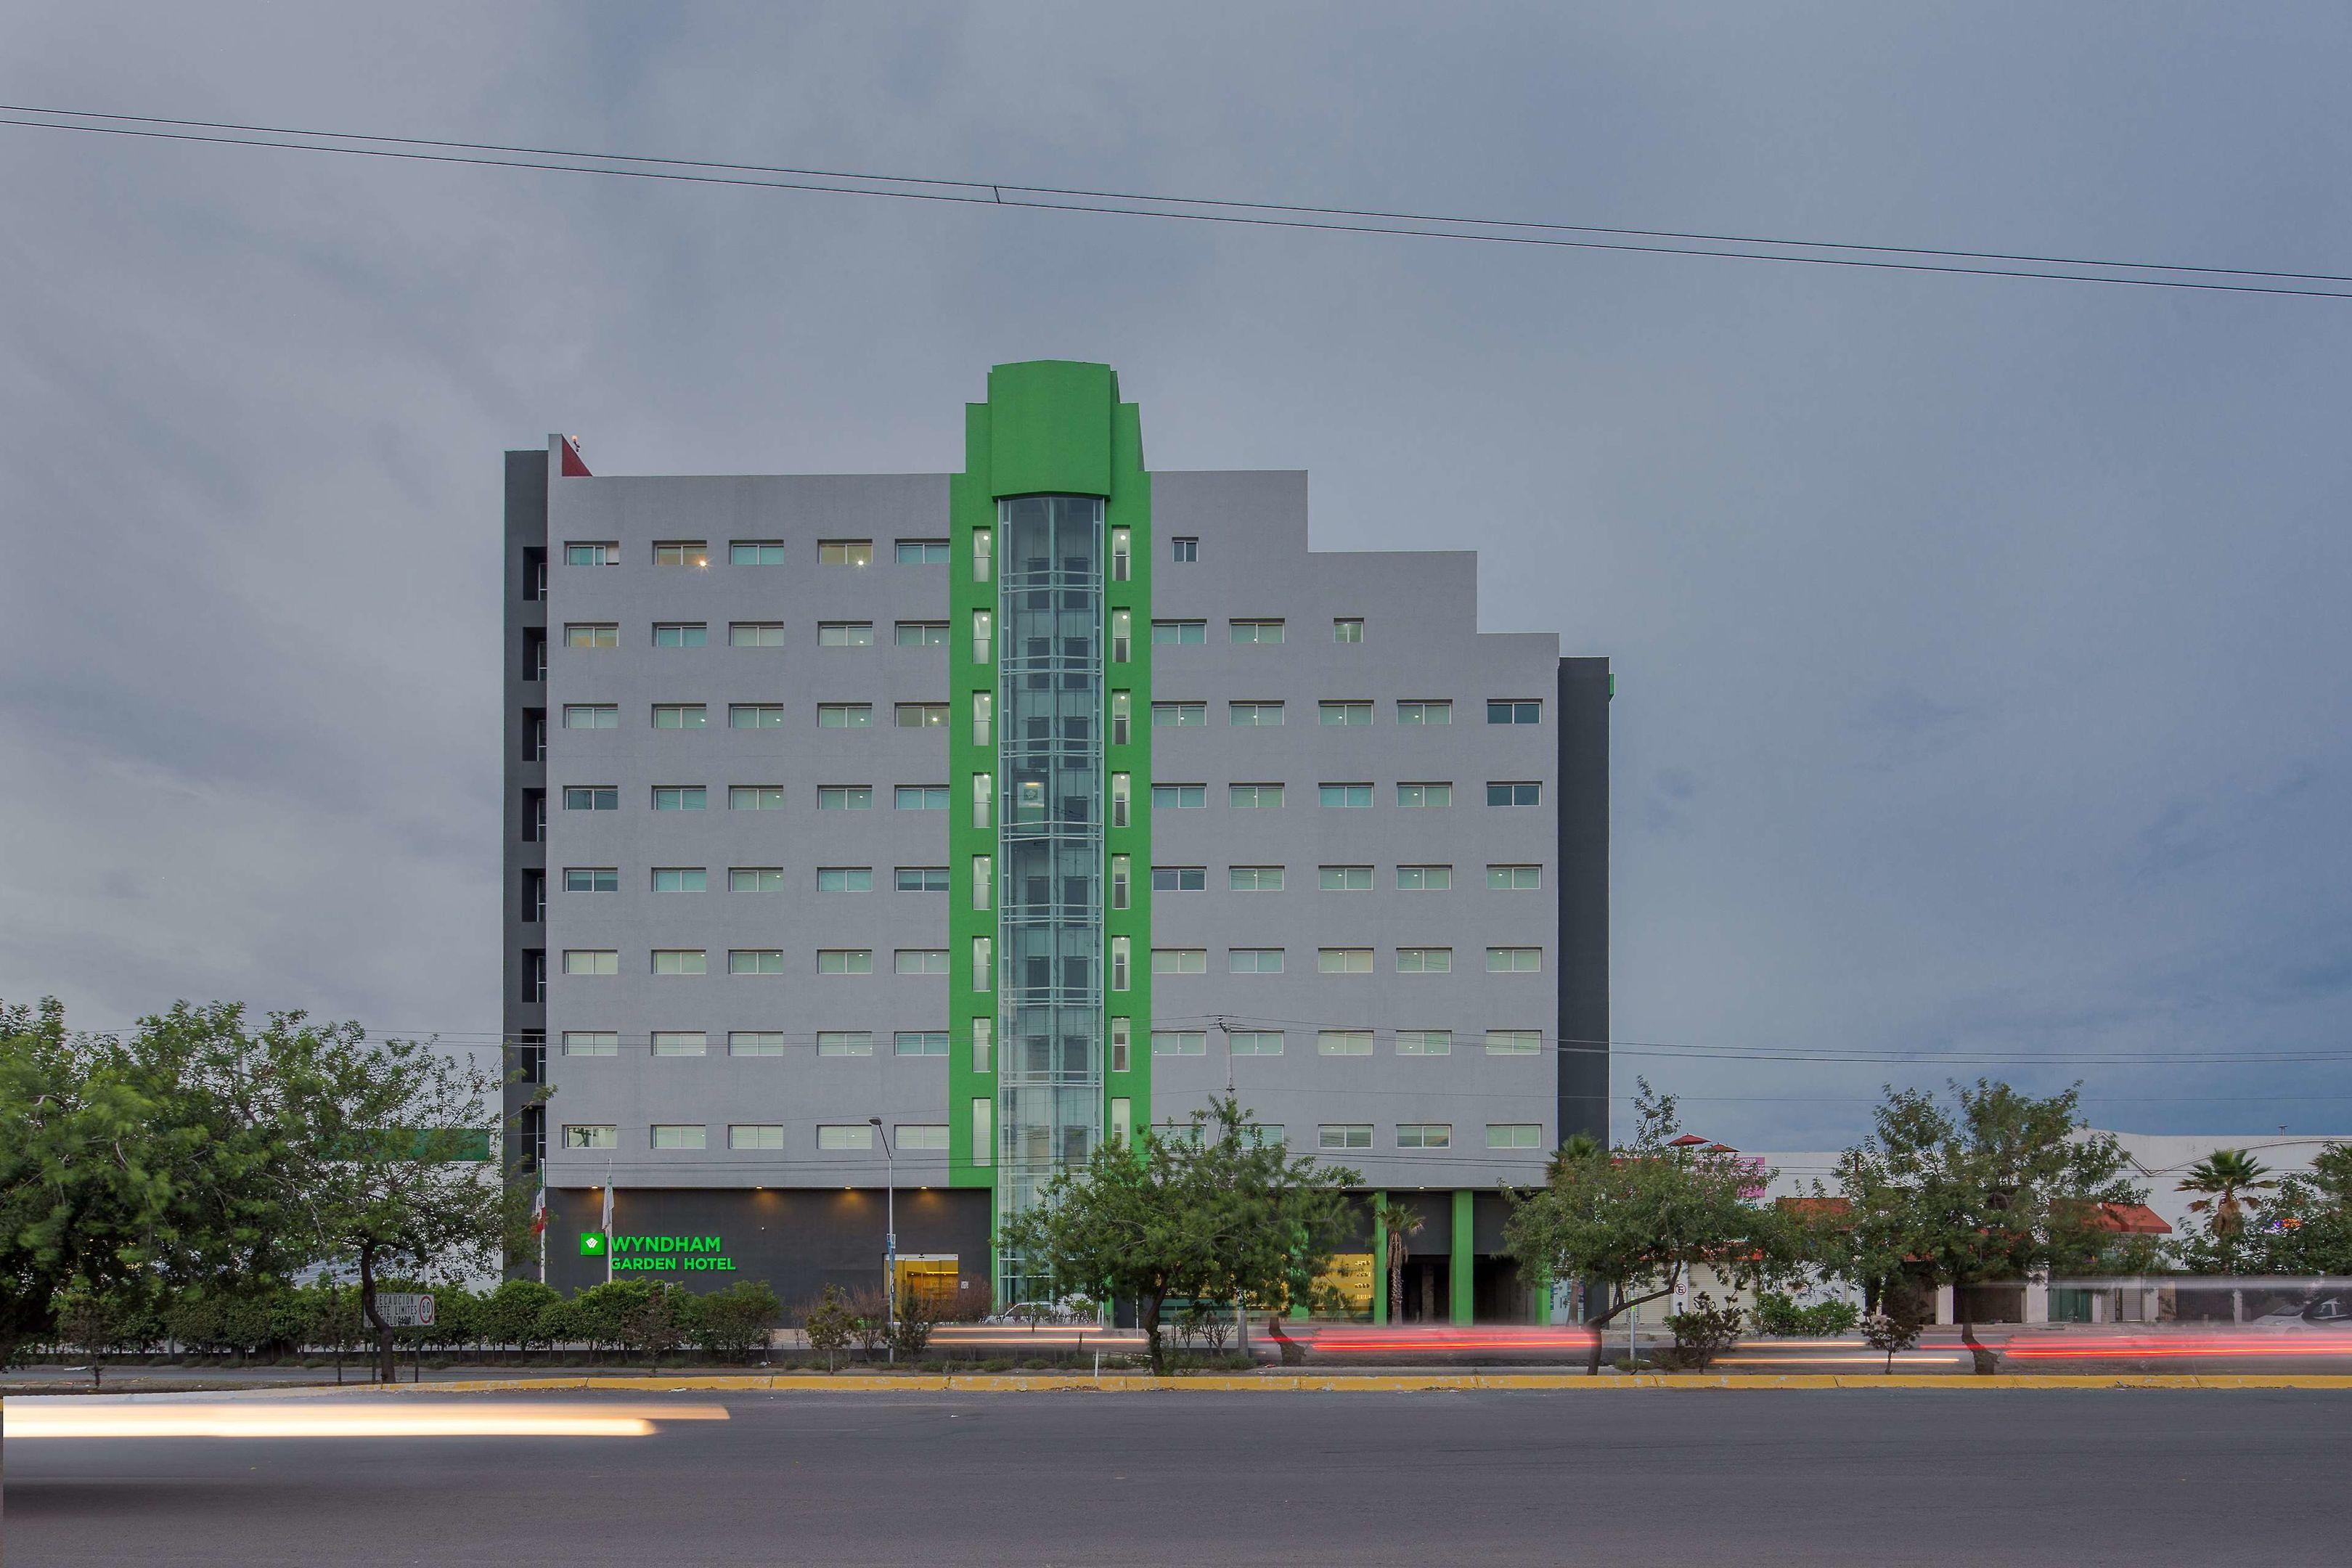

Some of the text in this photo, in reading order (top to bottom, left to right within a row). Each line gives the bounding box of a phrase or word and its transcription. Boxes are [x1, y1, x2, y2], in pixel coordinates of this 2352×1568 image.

[611, 1236, 721, 1252] WYNDHAM
[611, 1257, 736, 1270] GARDEN HOTEL
[395, 1305, 417, 1315] LIMITES
[422, 1302, 430, 1313] 60
